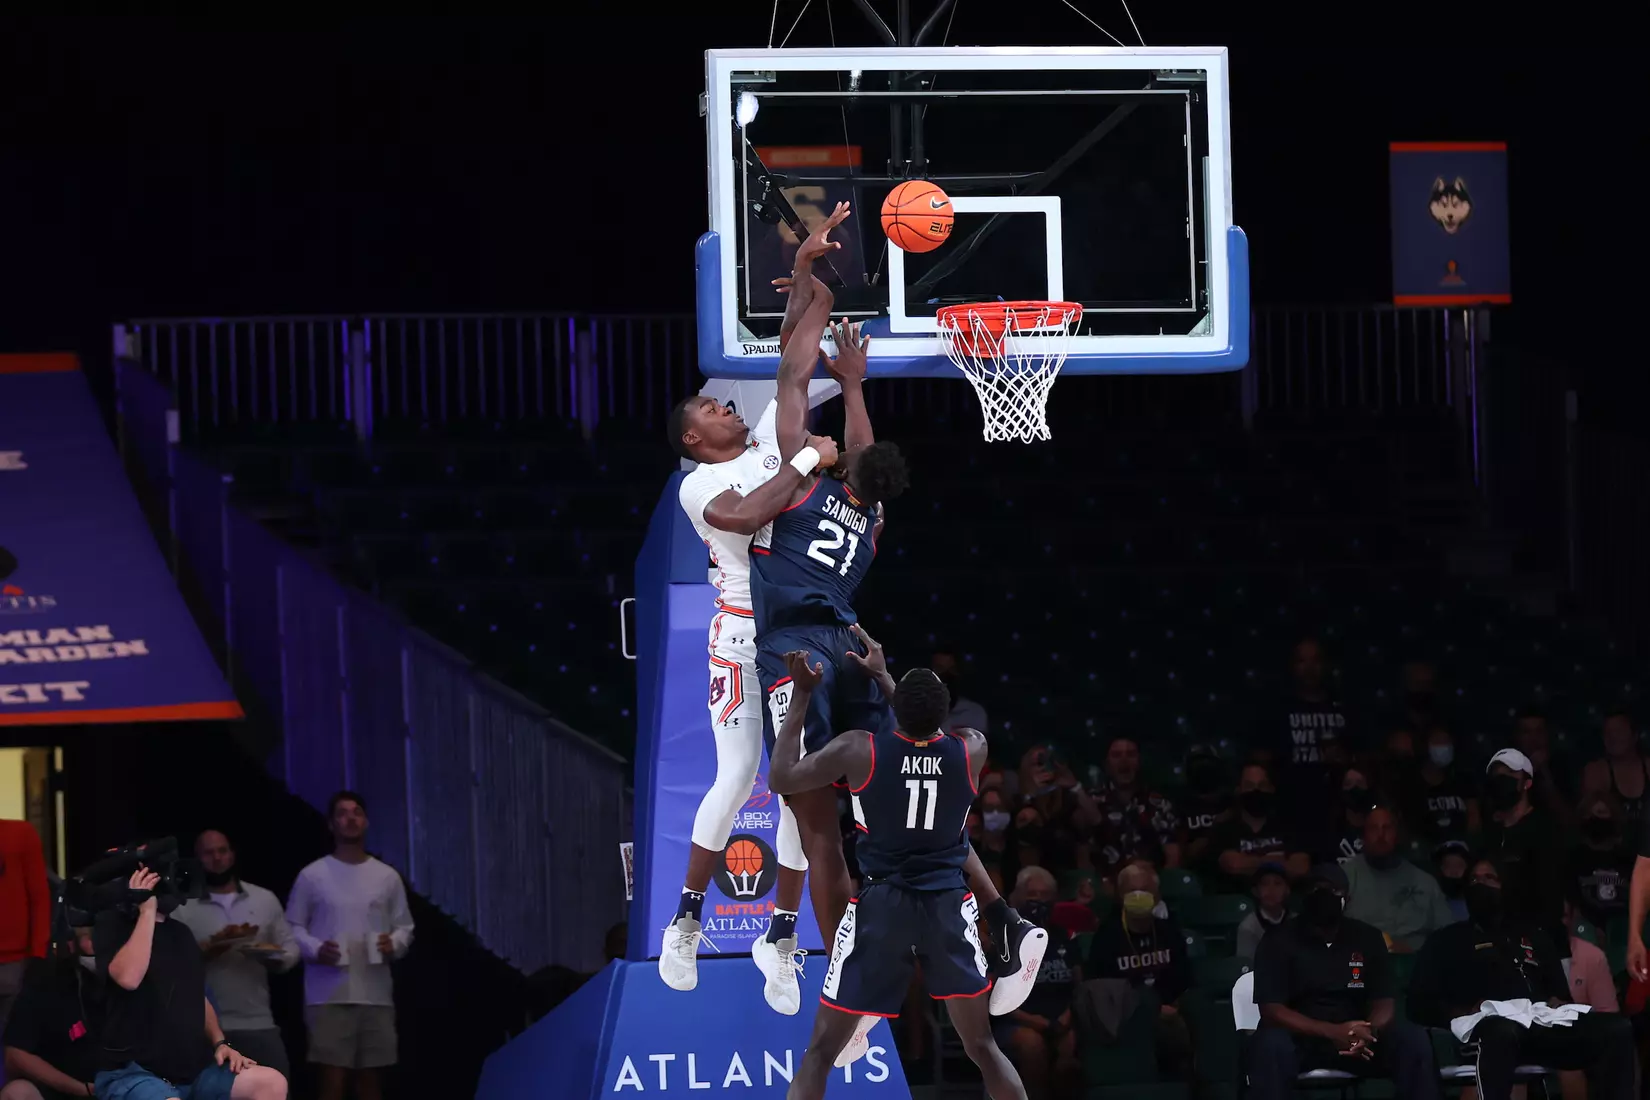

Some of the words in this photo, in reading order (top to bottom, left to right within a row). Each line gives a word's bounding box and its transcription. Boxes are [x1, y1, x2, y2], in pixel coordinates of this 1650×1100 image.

[743, 344, 780, 355] SPALDI
[822, 495, 868, 534] SANOGO
[807, 520, 859, 576] 21
[0, 625, 114, 646] MIAN
[0, 640, 149, 664] ARDEN
[0, 681, 90, 703] KIT
[1289, 713, 1345, 728] UNITED
[1292, 729, 1316, 744] WE
[1292, 747, 1319, 763] STA
[901, 756, 942, 775] AKOK
[906, 780, 937, 829] 11
[732, 820, 773, 829] WERS
[744, 812, 771, 820] BOY
[1188, 814, 1216, 829] UC
[715, 904, 764, 915] BATTLE
[824, 909, 854, 990] HUSKIES
[613, 1045, 890, 1092] ATLANIS
